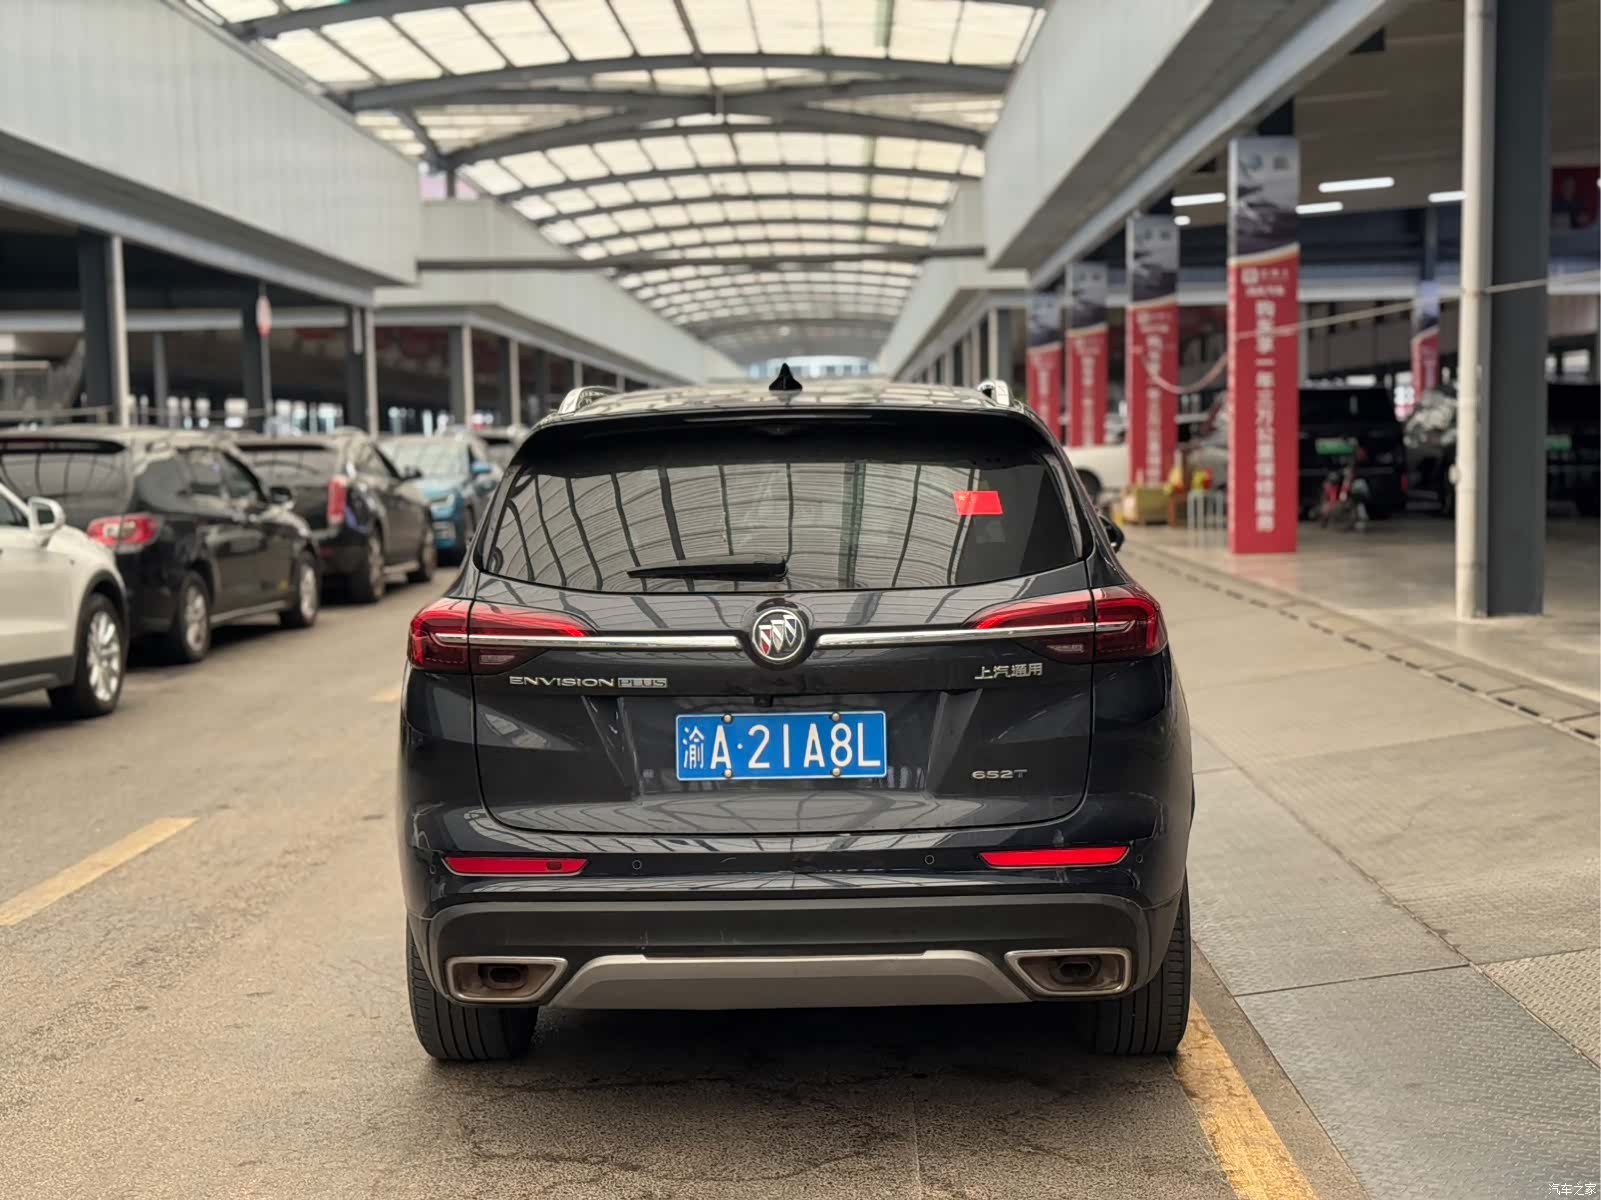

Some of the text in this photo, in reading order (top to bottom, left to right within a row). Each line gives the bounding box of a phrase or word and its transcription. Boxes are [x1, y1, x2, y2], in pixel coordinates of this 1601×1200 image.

[974, 662, 1043, 680] 上汽通用
[509, 676, 667, 688] ENVISION PLUS
[971, 769, 1028, 780] 652T
